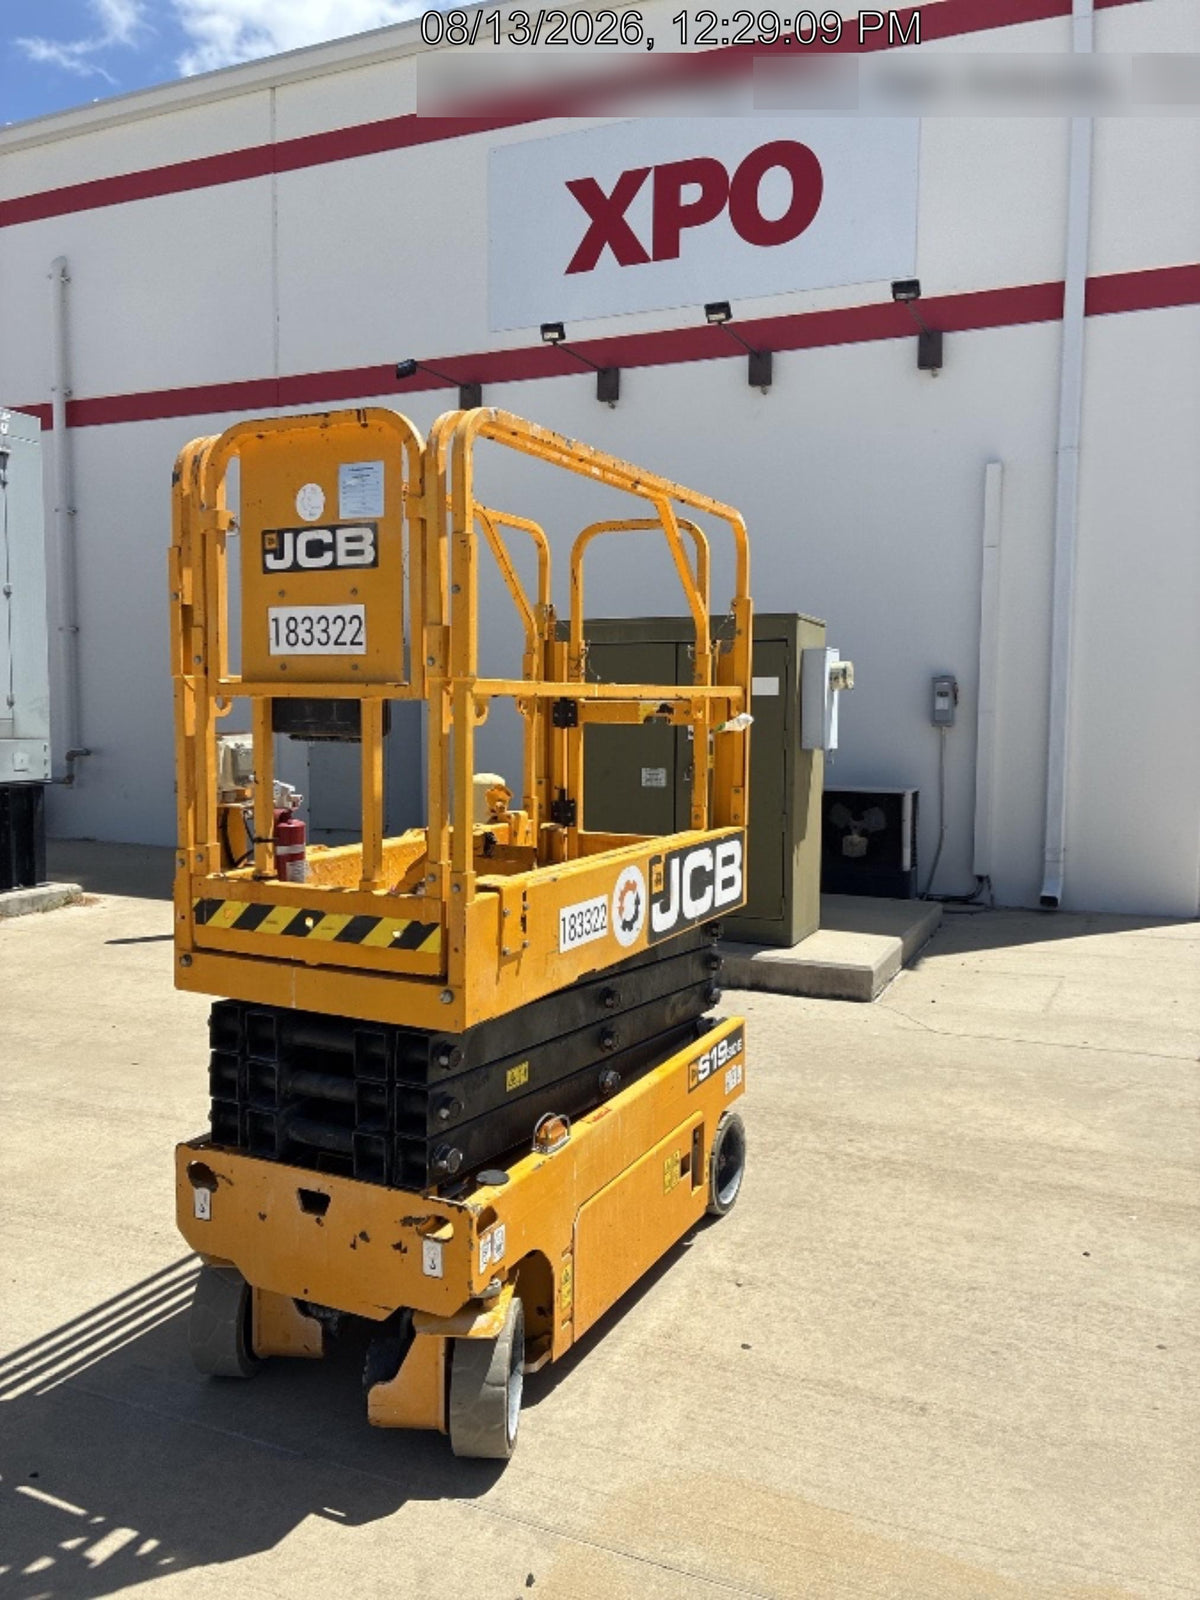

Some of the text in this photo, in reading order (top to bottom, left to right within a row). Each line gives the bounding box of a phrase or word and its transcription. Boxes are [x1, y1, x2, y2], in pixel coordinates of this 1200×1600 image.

[564, 140, 824, 275] XPO
[265, 527, 376, 570] JCB
[271, 614, 364, 647] 183322
[651, 840, 742, 933] JCB
[561, 903, 607, 944] 183322
